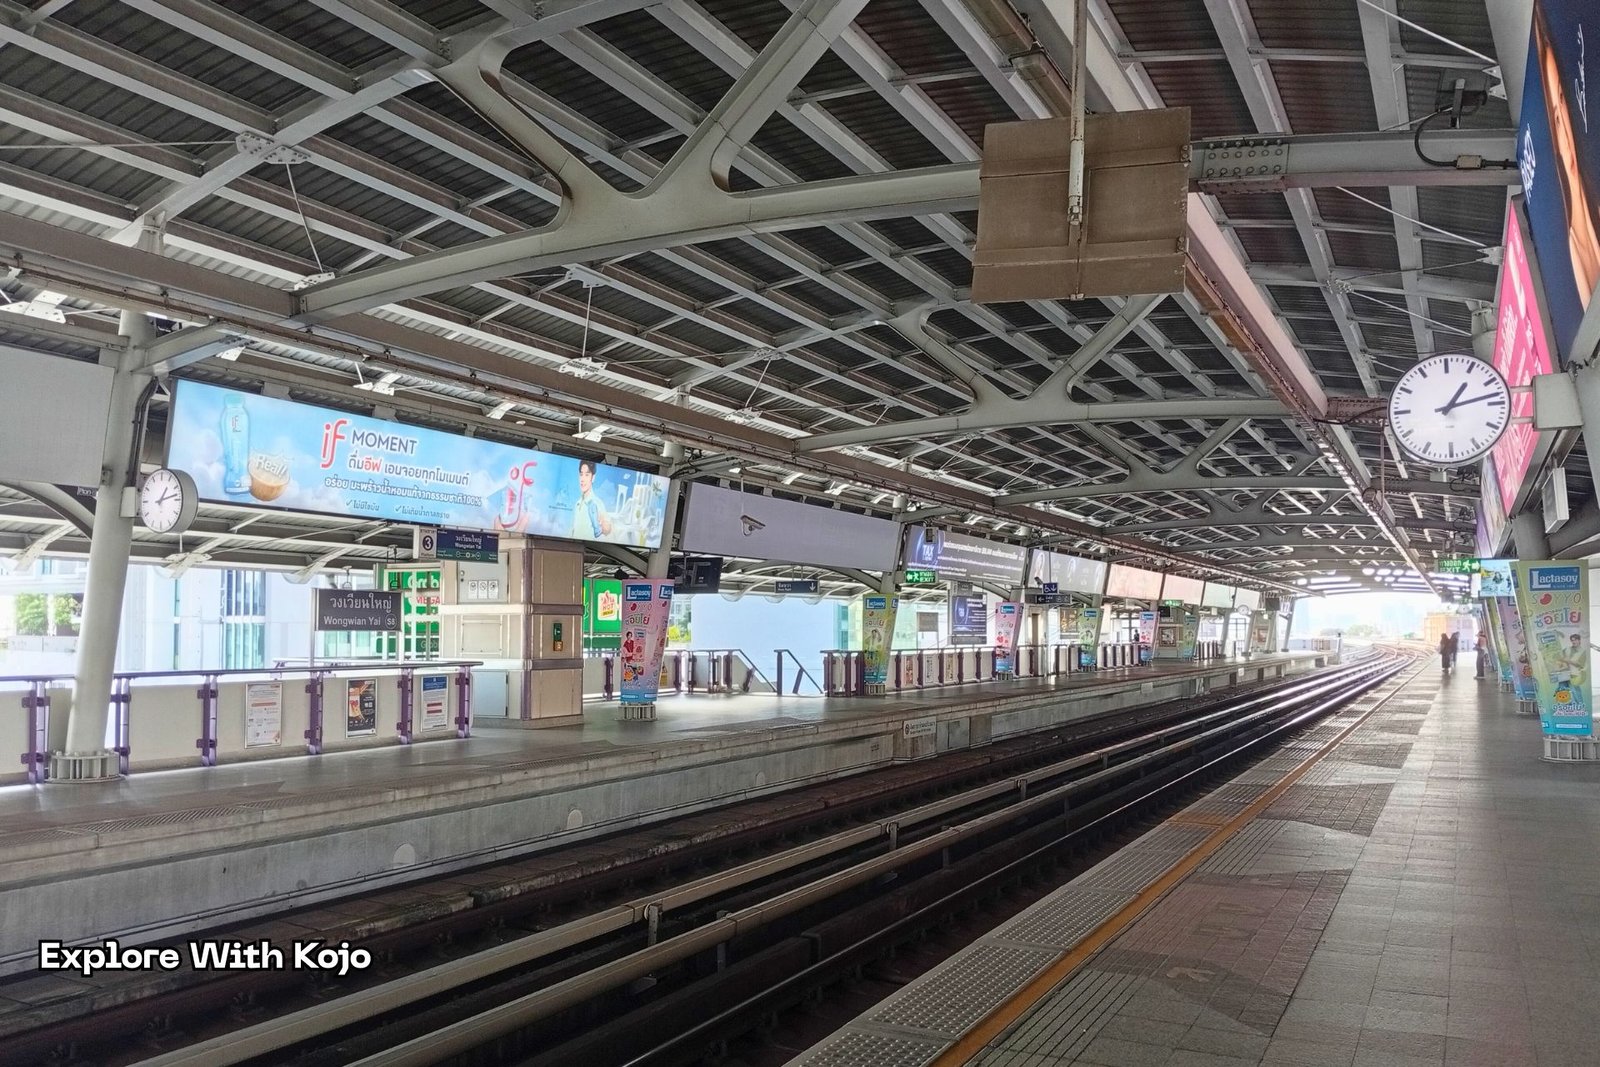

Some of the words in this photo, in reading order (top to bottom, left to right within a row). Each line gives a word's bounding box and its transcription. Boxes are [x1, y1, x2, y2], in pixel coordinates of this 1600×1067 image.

[321, 419, 347, 468] if
[352, 429, 418, 454] MOMENT
[256, 455, 287, 477] Real!
[349, 450, 381, 472] ดื่มอีฟ
[384, 462, 470, 486] เอนจอยทุกโมเมนต์
[325, 473, 349, 489] อร่อย
[425, 537, 431, 550] 3
[923, 545, 935, 557] TAX
[1532, 570, 1578, 588] Lactasoy
[627, 586, 650, 599] Lactasoy
[330, 592, 392, 613] วงเวียนใหญ่
[323, 616, 367, 627] Wongwian
[368, 617, 381, 625] Yai
